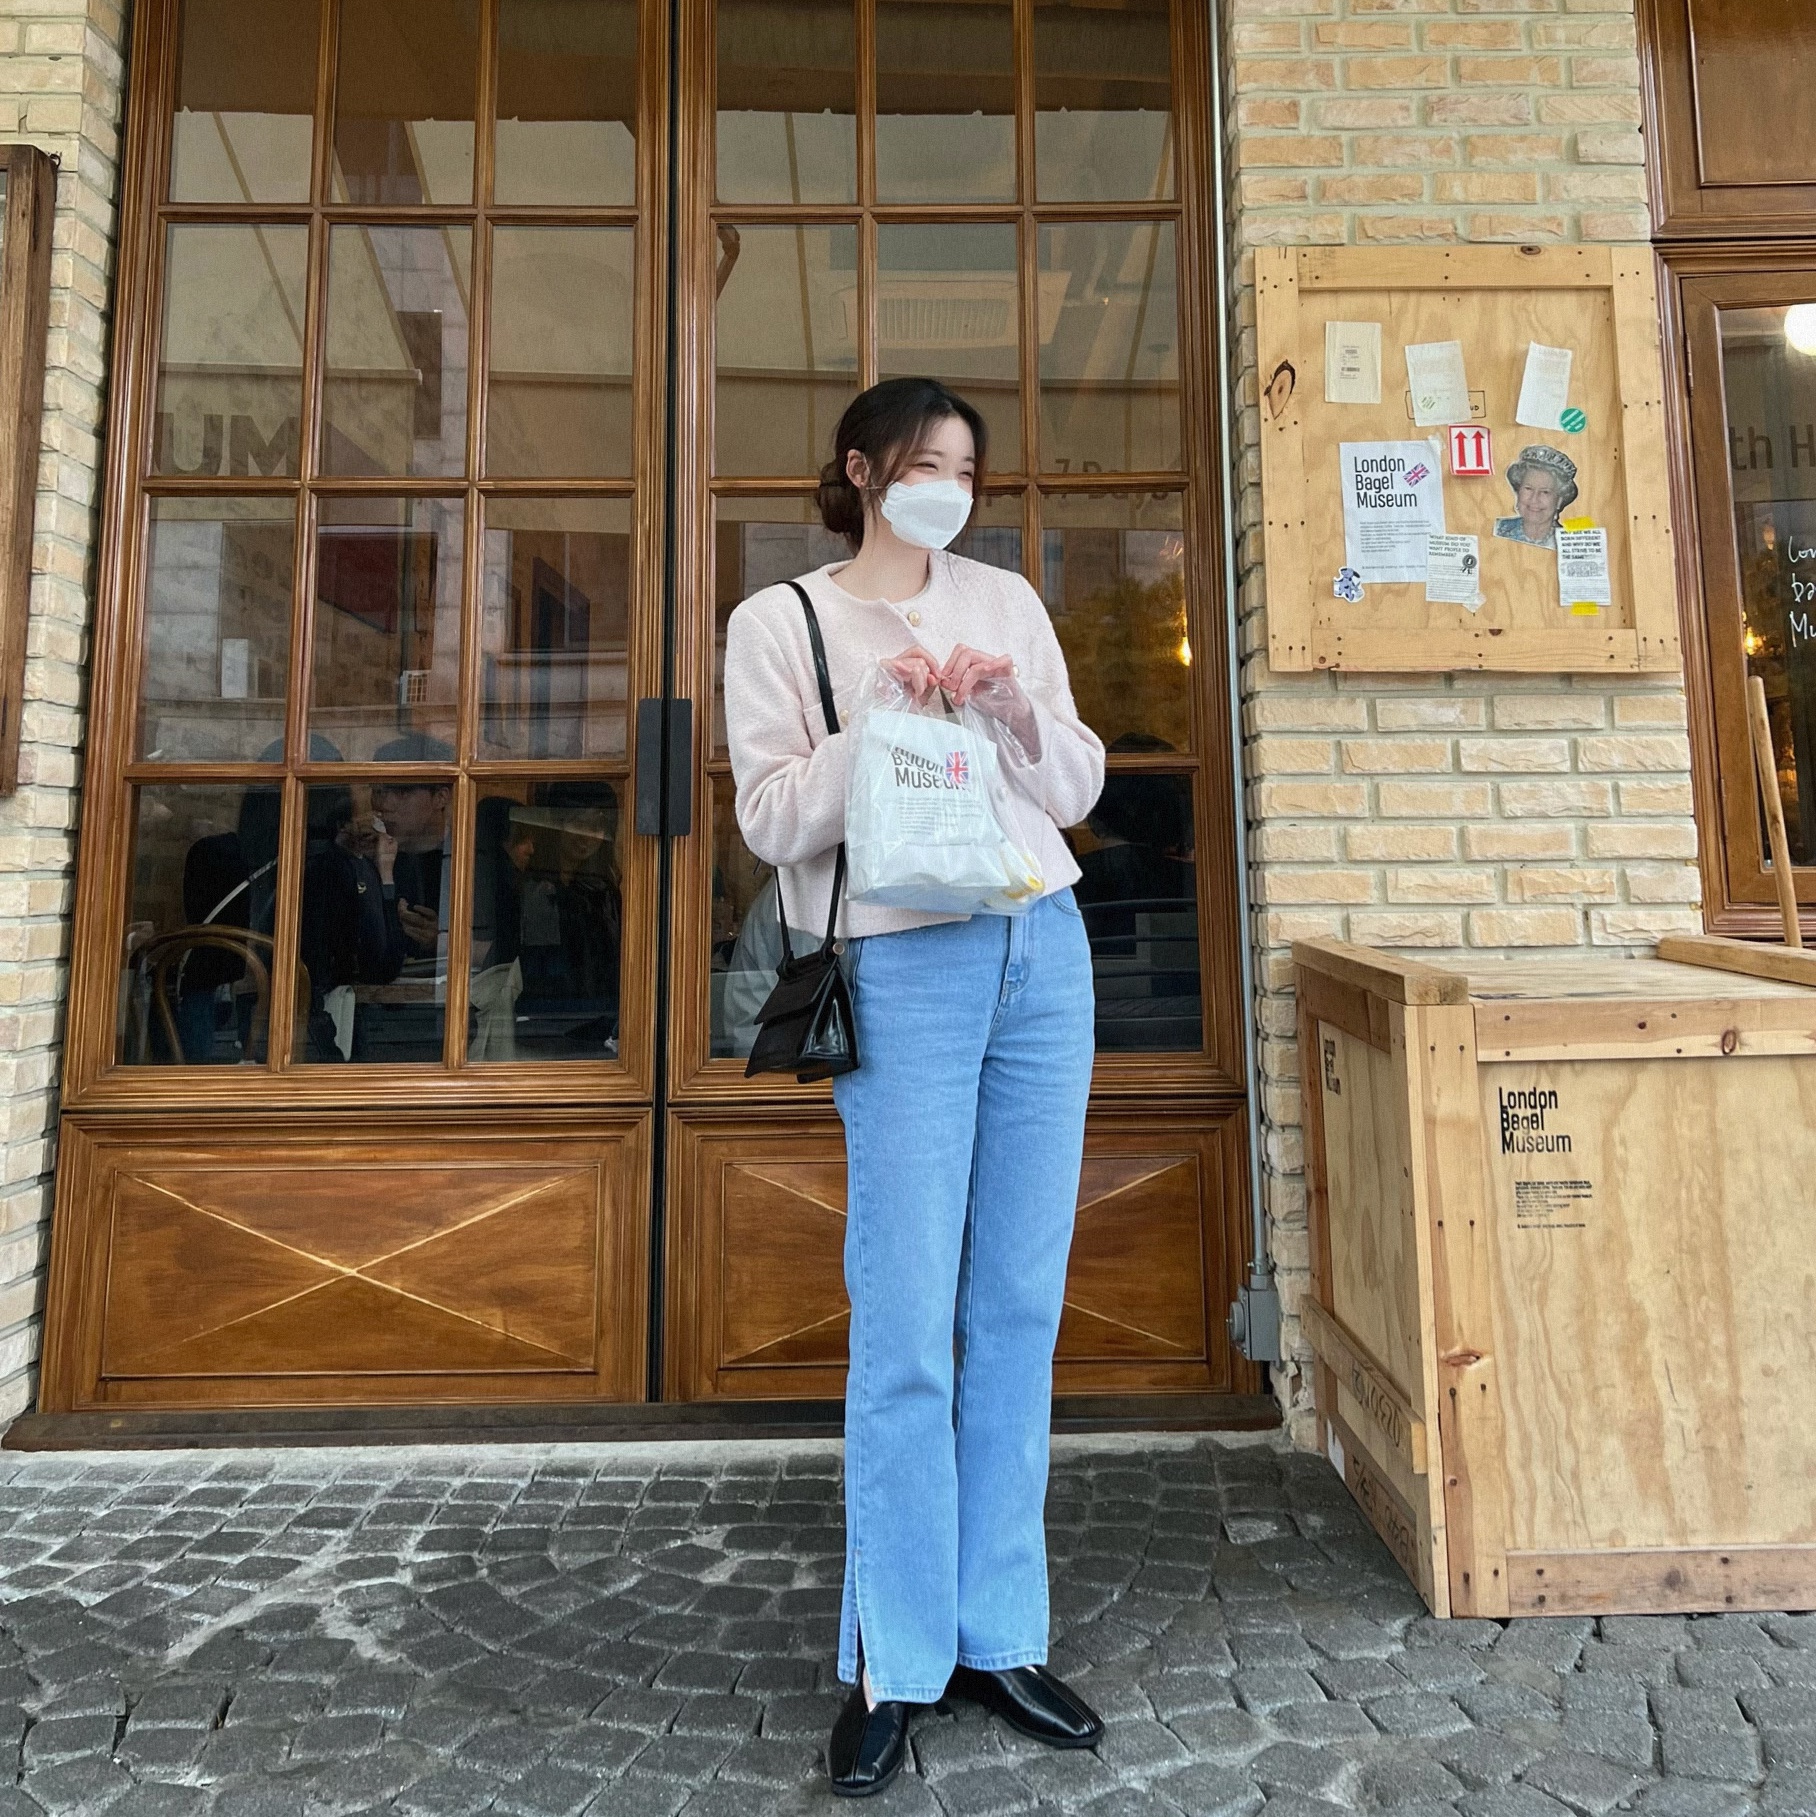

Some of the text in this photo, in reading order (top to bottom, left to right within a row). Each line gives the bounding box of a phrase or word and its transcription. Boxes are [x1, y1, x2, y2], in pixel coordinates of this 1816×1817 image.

[1354, 455, 1406, 474] London
[1355, 473, 1395, 494] Bagel
[1356, 492, 1418, 509] Museum
[1498, 1086, 1558, 1110] London
[1501, 1131, 1572, 1155] Museum
